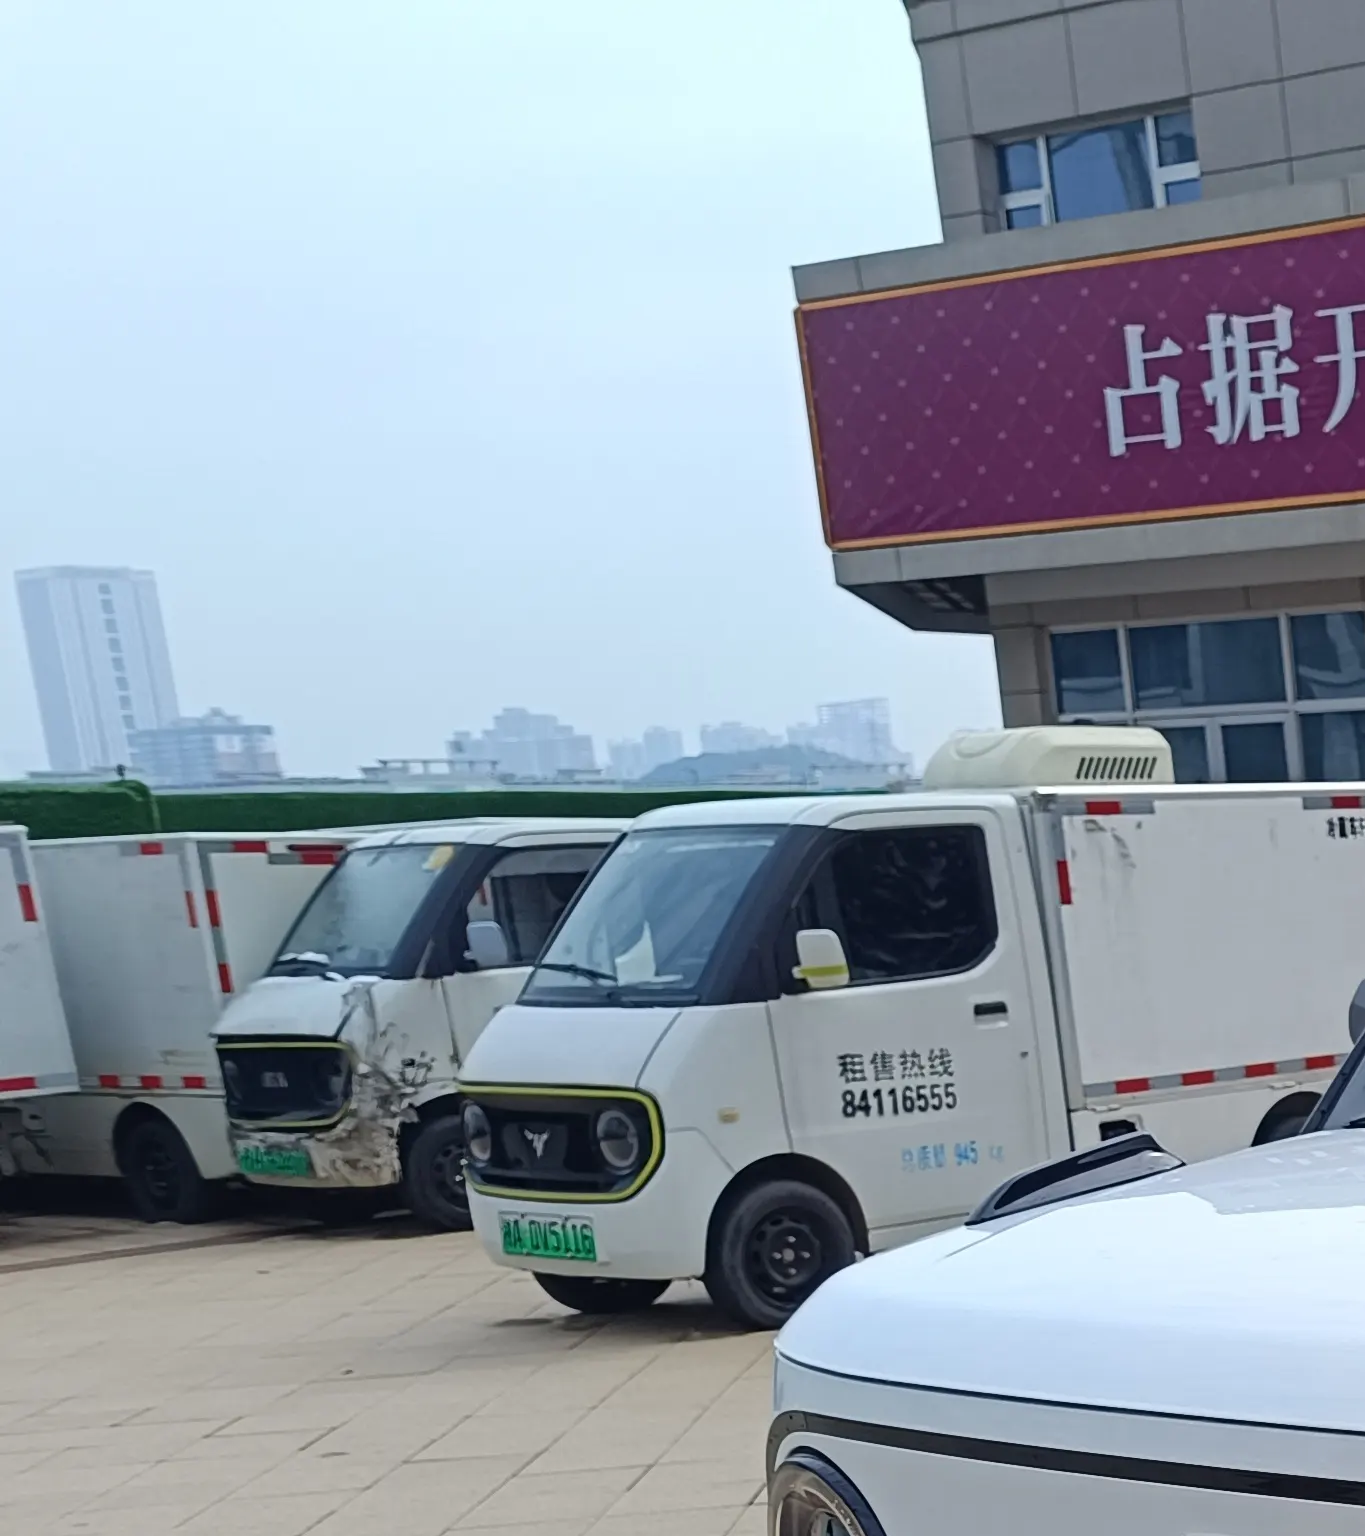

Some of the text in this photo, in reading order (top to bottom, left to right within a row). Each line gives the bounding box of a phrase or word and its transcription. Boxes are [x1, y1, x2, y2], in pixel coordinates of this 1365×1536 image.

[837, 1048, 954, 1083] 租售热线
[841, 1083, 957, 1118] 84116555
